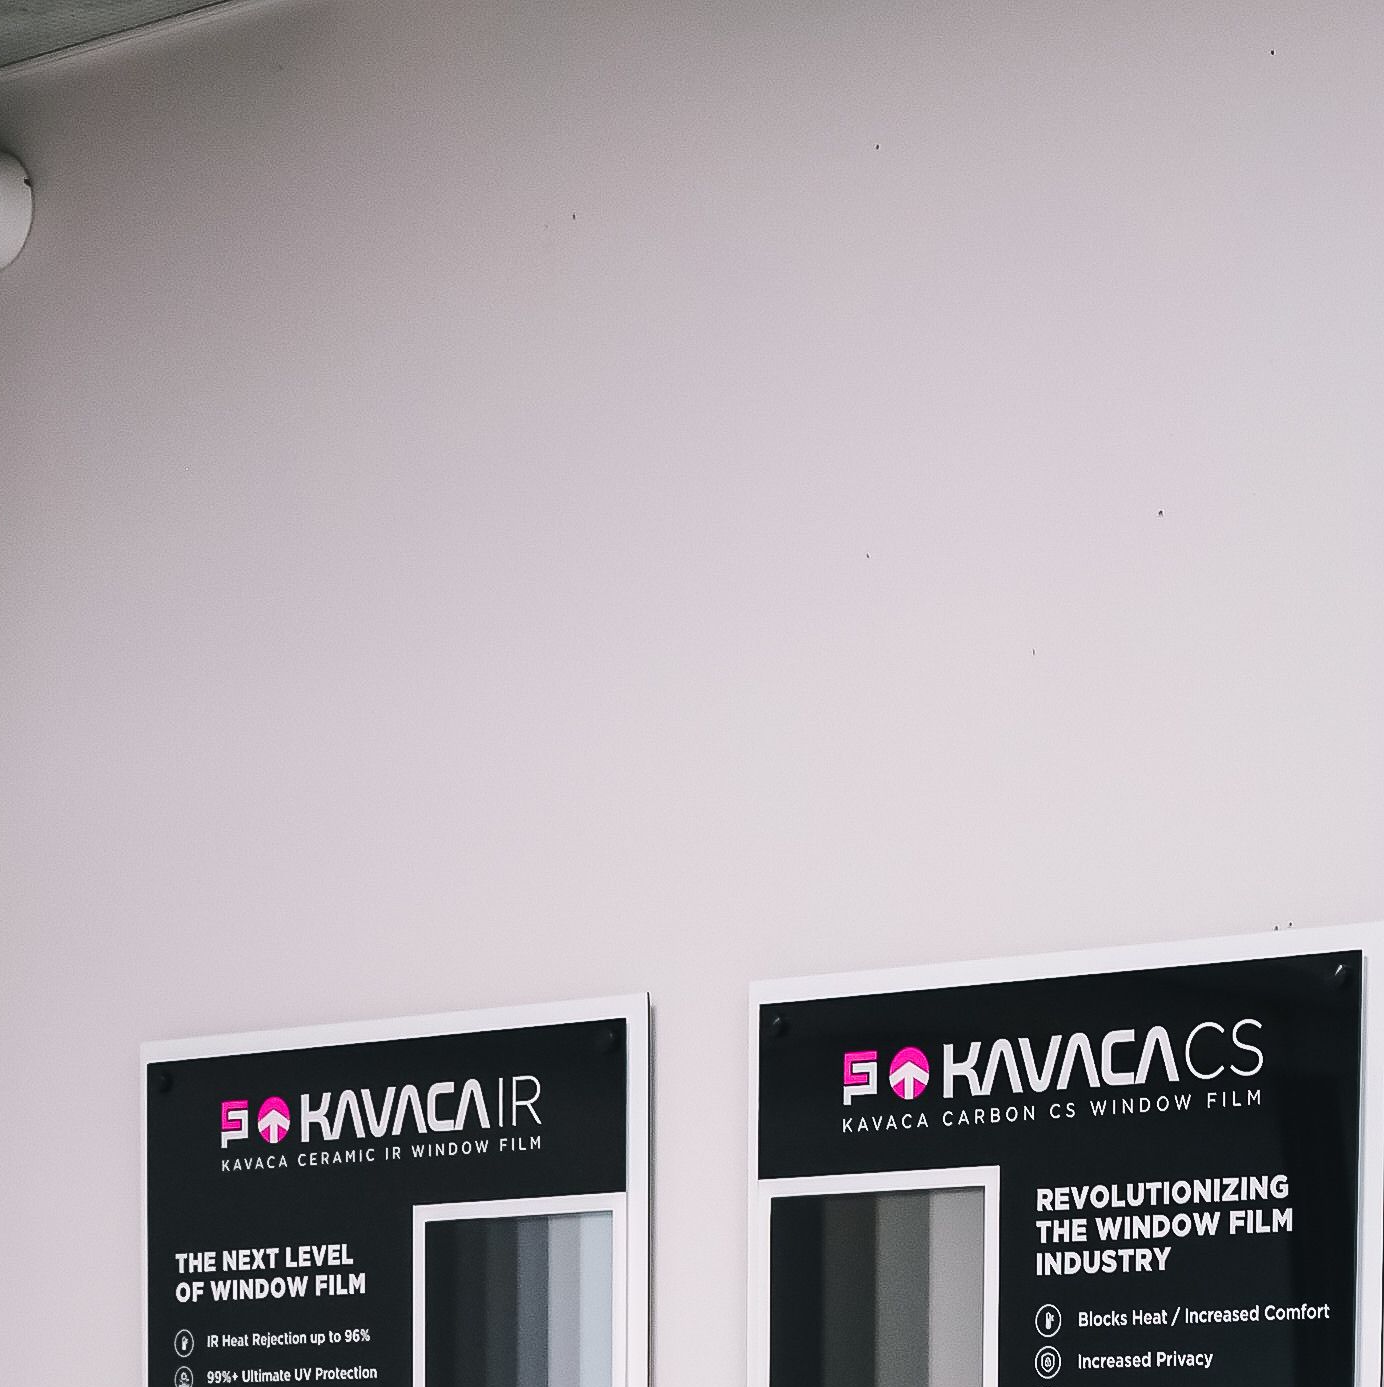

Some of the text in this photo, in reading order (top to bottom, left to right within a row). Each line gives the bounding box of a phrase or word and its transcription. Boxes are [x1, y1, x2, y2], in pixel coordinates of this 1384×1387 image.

[843, 1090, 1260, 1132] KAVACA CARBON CS WINDOW FILM
[222, 1136, 540, 1171] KAVACA CERAMIC IR WINDOW FILM
[1037, 1175, 1292, 1213] REVOLUTIONIZING
[1036, 1208, 1292, 1243] THE WINDOW FILM
[176, 1244, 353, 1273] THE NEXT LEVEL
[1037, 1247, 1171, 1275] INDUSTRY
[176, 1273, 365, 1302] OF WINDOW FILM
[1079, 1304, 1330, 1327] Blocks Heat / Increased Comfort
[207, 1329, 370, 1348] IR Heat Rejection up to 96%
[1079, 1351, 1213, 1369] Increased Privacy
[207, 1366, 377, 1384] 99%+ Ultimate UV Protection
